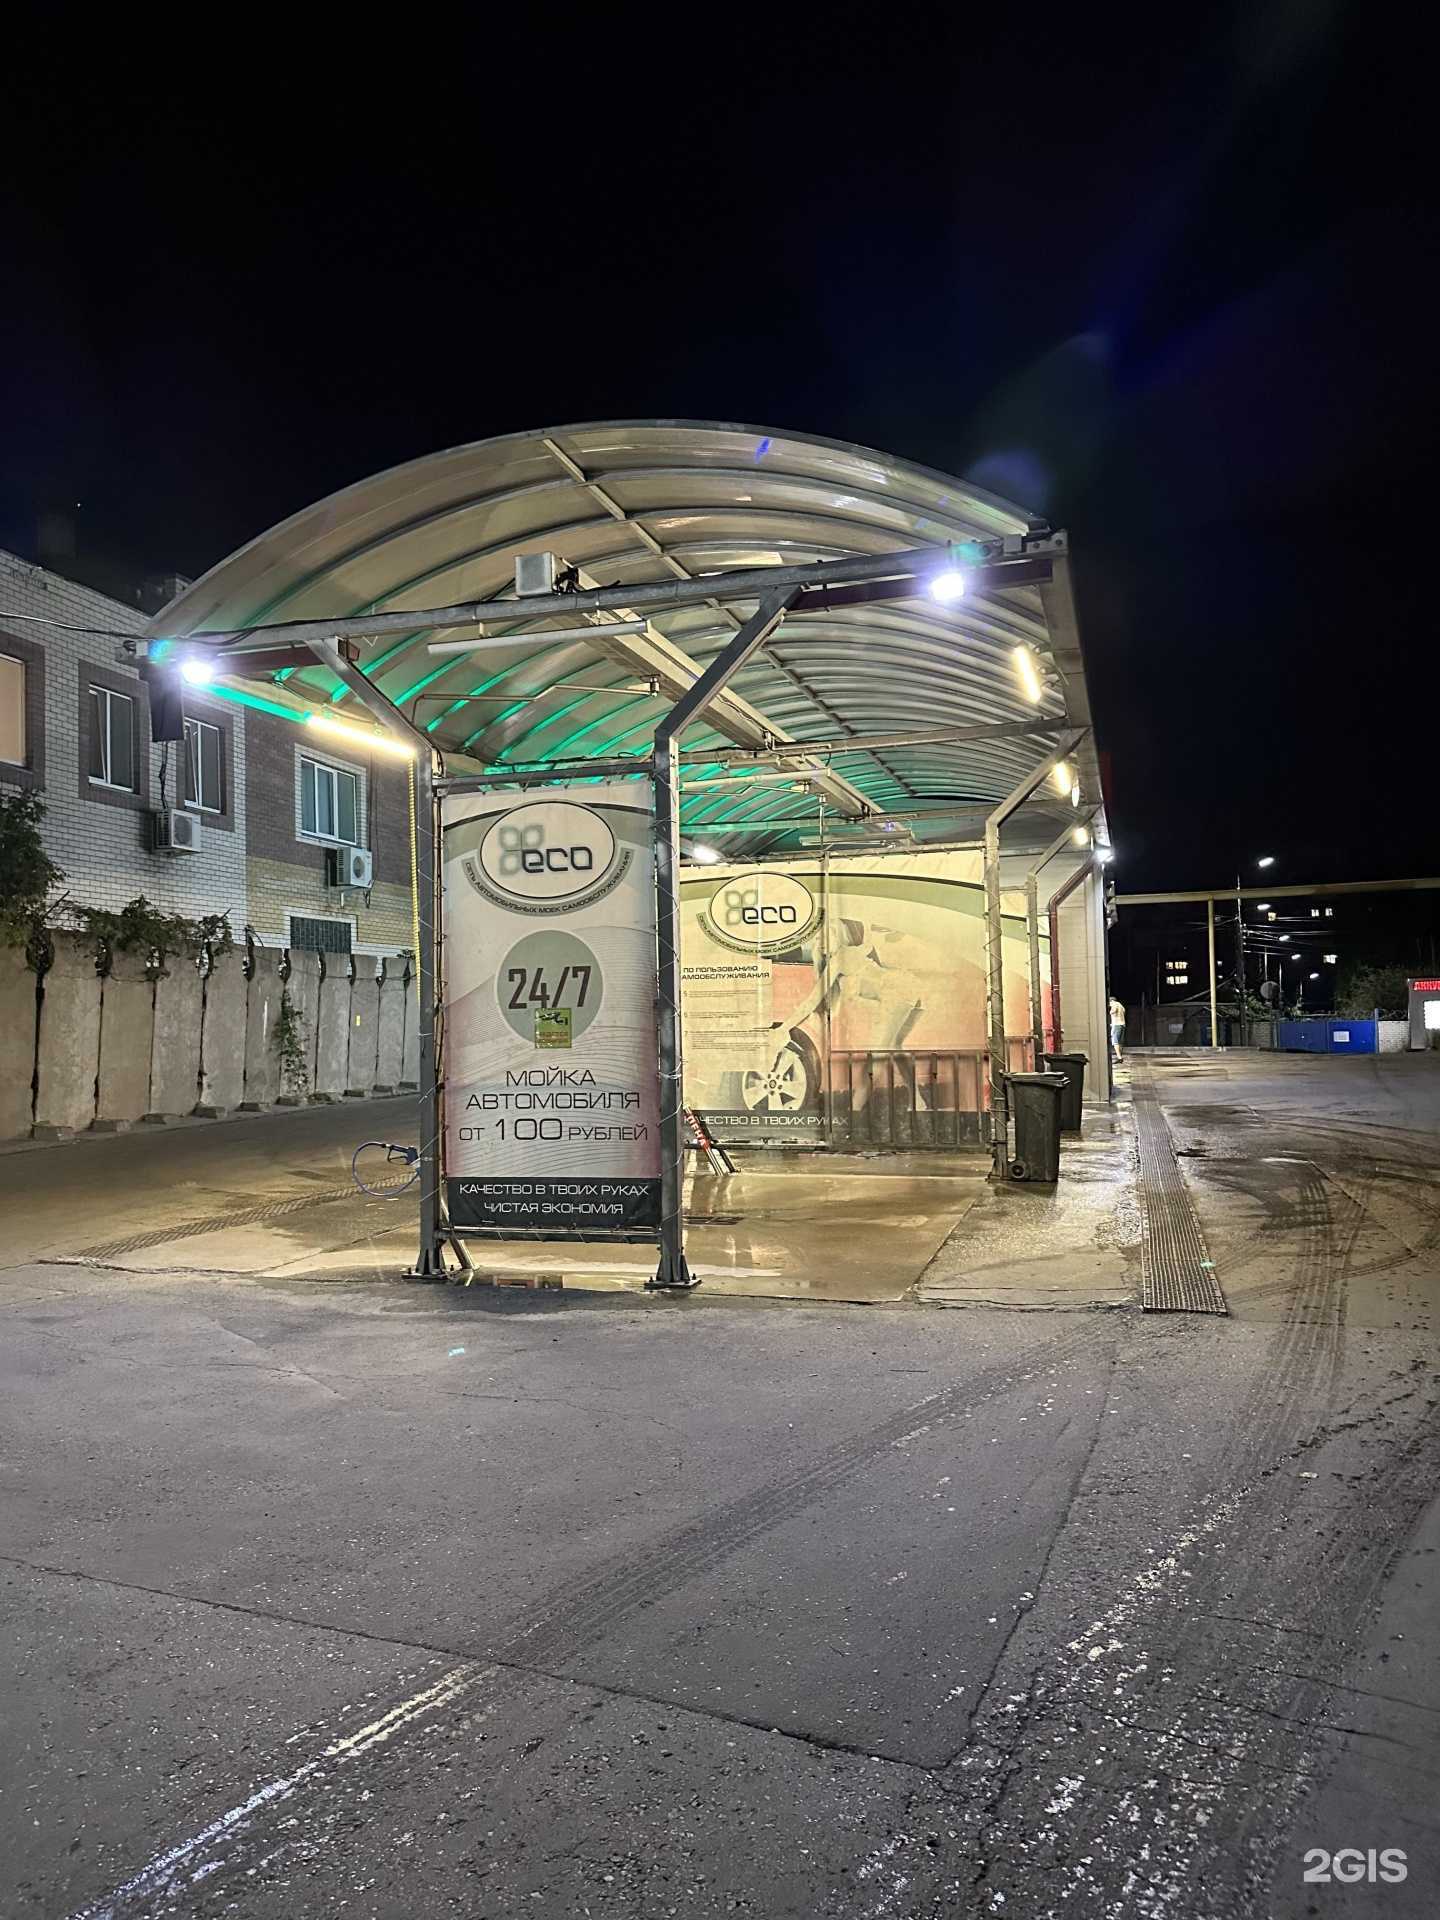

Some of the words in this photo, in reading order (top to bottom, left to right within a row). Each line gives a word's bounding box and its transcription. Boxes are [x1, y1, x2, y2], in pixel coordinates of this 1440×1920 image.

[522, 846, 593, 874] eco
[477, 881, 538, 914] АВТОМОБИЛЬНЫХ
[539, 906, 561, 914] МОЕК
[681, 972, 770, 980] АМООБСЛУЖИВАНИЯ
[696, 965, 758, 973] ПОЛЬЗОВАНИЮ
[508, 965, 592, 1010] 24/7
[506, 1066, 597, 1087] МОЙКА
[465, 1092, 641, 1110] АВТОМОБИЛЯ
[495, 1118, 563, 1141] 100
[568, 1123, 648, 1141] РУБЛЕЙ
[684, 1116, 748, 1125] ЧЕСТВО
[750, 1116, 760, 1125] В
[764, 1116, 805, 1125] ТВОИХ
[459, 1184, 533, 1194] КАЧЕСТВО
[535, 1184, 546, 1194] В
[549, 1184, 599, 1195] ТВОИХ
[601, 1185, 649, 1196] РУКАХ
[484, 1202, 539, 1213] ЧИСТАЯ
[541, 1203, 624, 1214] ЭКОНОМИЯ
